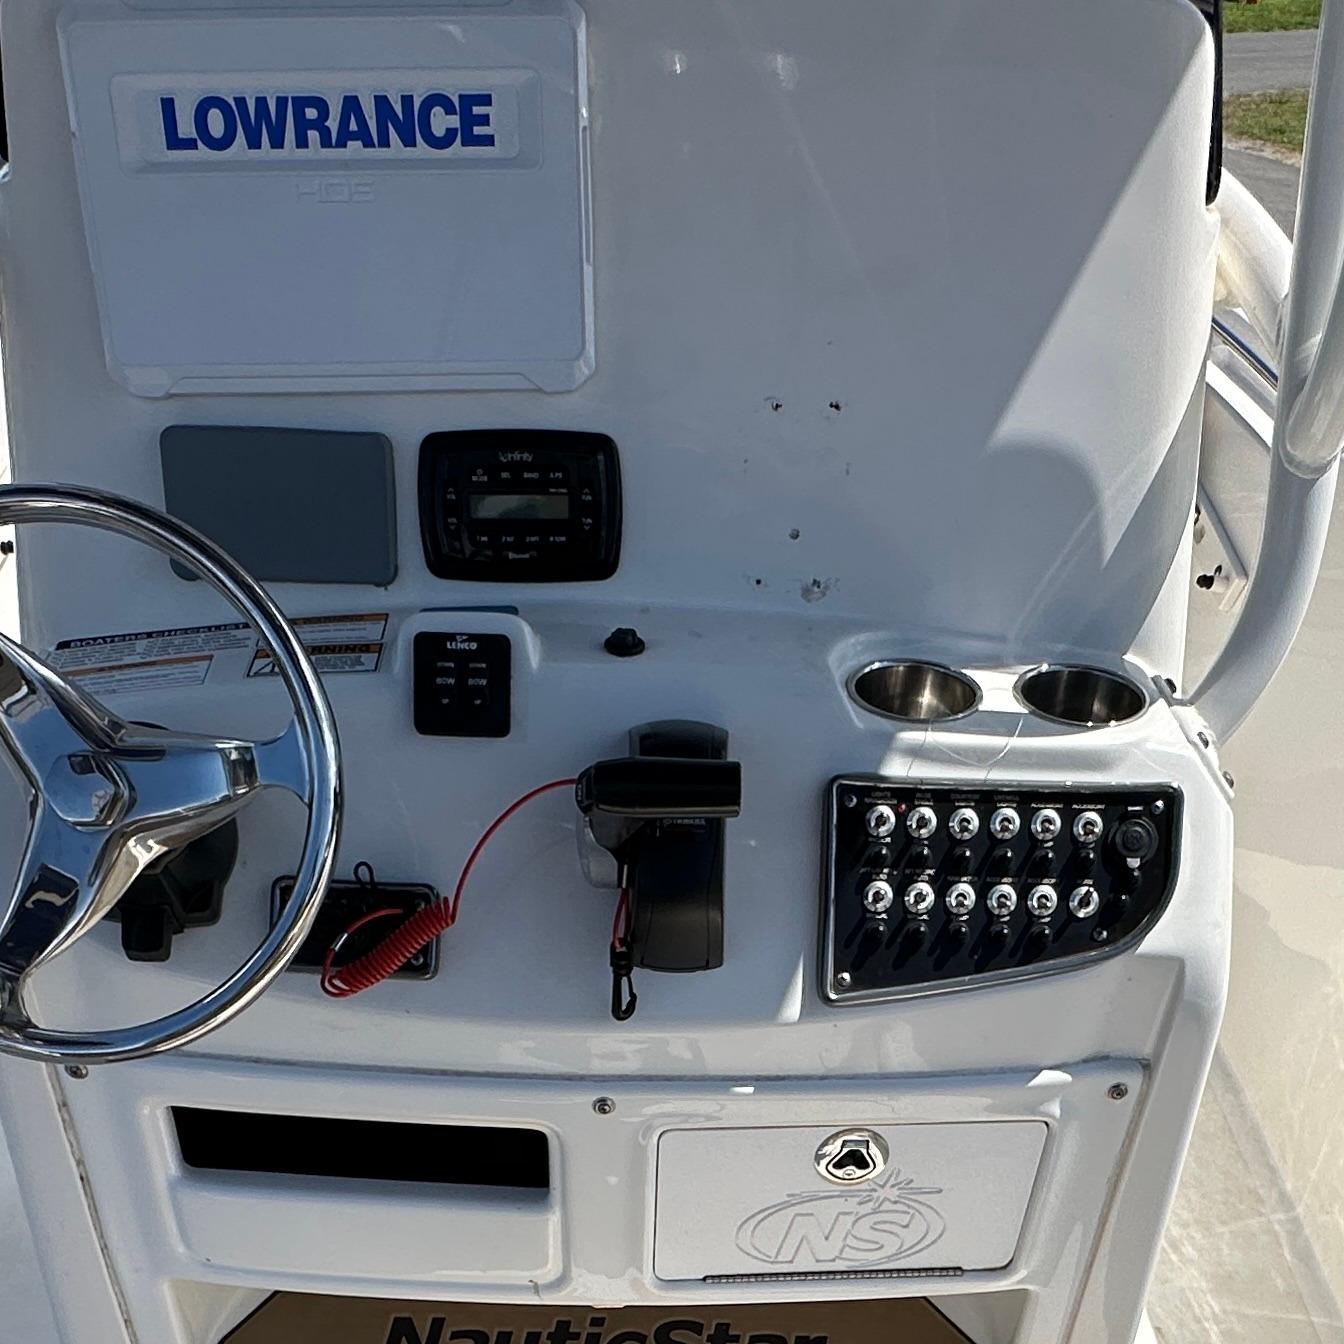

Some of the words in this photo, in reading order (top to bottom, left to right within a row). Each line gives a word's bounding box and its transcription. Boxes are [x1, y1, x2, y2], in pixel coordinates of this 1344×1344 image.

[160, 93, 496, 152] LOWRANCE
[70, 633, 147, 648] BOATERS
[152, 623, 248, 639] CHECKLIST
[446, 641, 478, 650] LENCO
[773, 1210, 916, 1265] NS
